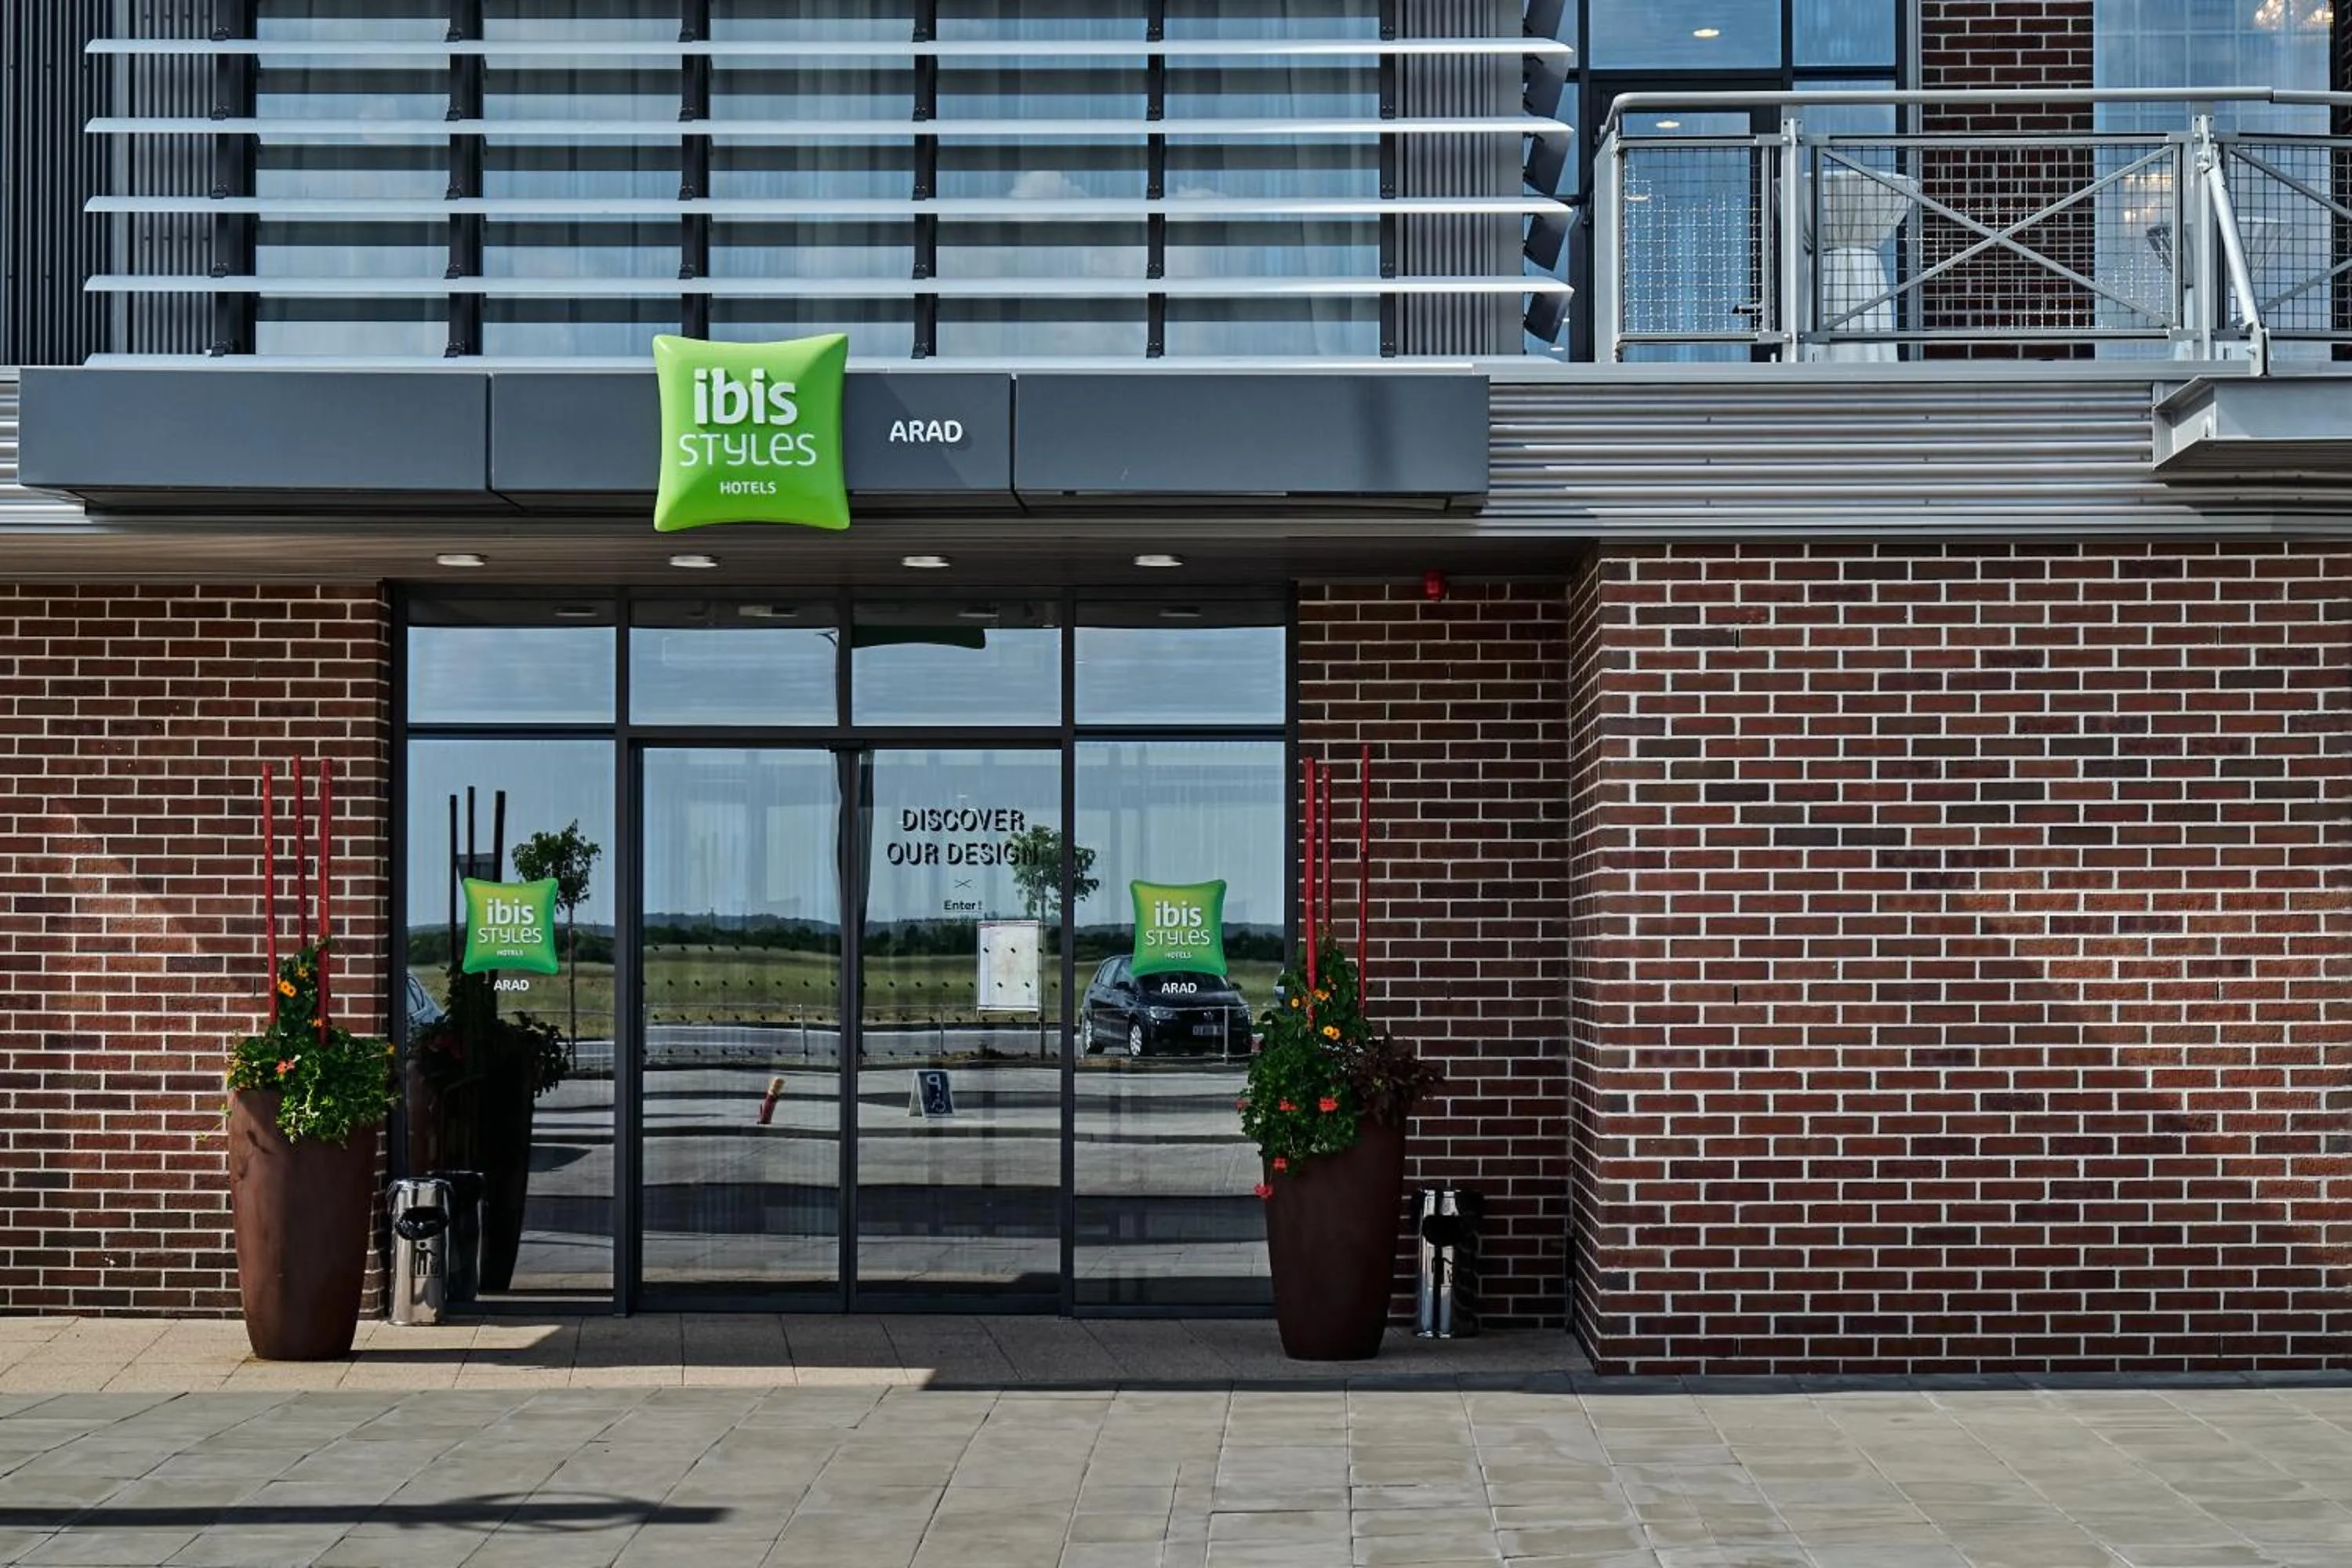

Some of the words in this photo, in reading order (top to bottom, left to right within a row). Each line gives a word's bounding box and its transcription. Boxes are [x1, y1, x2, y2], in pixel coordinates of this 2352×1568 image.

[694, 368, 797, 425] ibis
[889, 419, 964, 443] ARAD
[720, 481, 776, 494] HOTELS
[902, 808, 1025, 832] DISCOVER
[887, 843, 939, 866] OUR
[947, 843, 1038, 866] DESIGN
[487, 898, 534, 924] ibis
[1155, 901, 1201, 927] ibis
[493, 979, 529, 991] ARAD
[1161, 982, 1197, 993] ARAD
